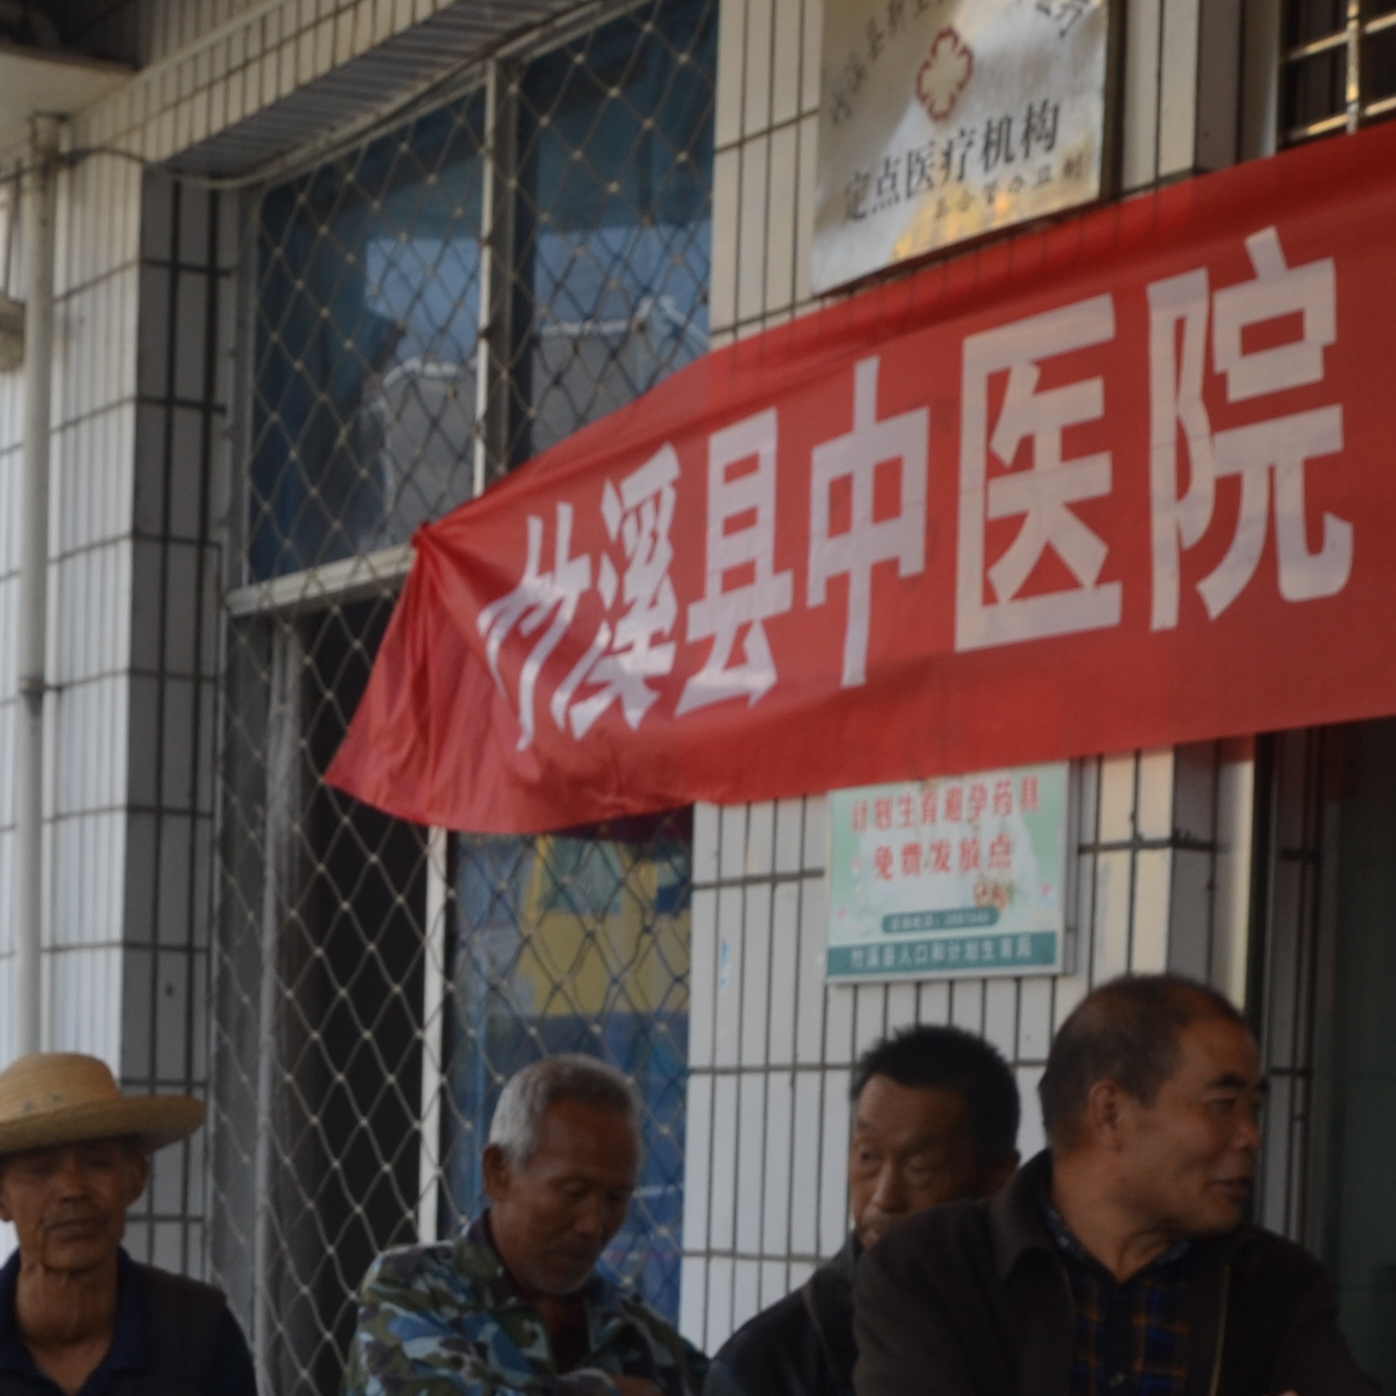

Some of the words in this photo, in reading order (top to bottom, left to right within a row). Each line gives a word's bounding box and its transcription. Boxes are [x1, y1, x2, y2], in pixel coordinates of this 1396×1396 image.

[843, 100, 1060, 223] 定点医疗机构
[478, 226, 1353, 750] 竹溪县中医院
[874, 832, 1013, 881] 免费发放点
